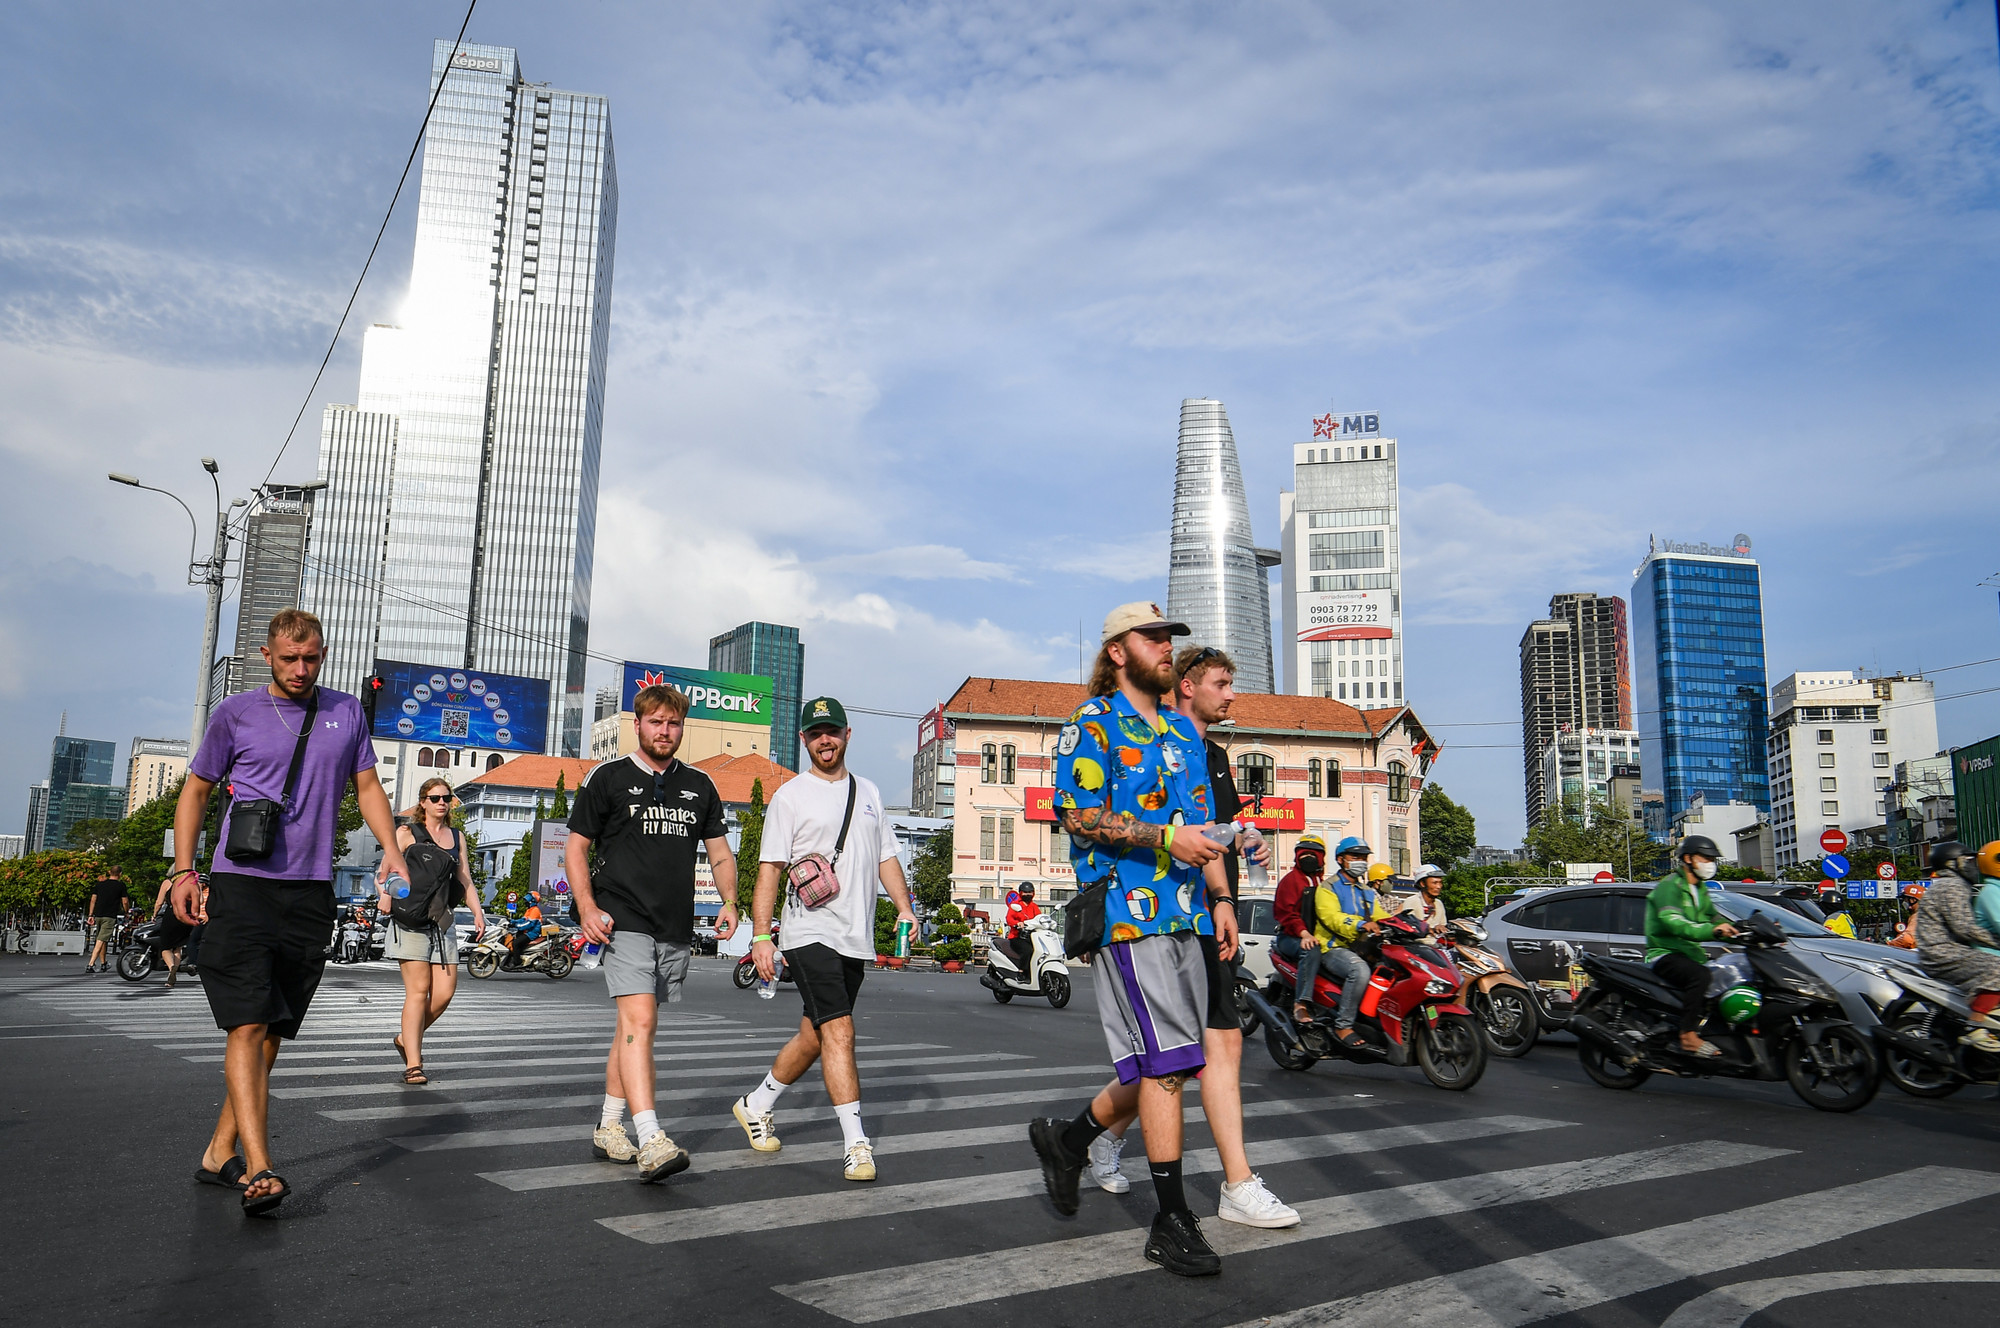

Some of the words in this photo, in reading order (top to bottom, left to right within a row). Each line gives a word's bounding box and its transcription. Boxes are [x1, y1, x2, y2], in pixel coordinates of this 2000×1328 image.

[450, 54, 499, 70] Keppel
[1343, 414, 1379, 434] MB
[266, 500, 300, 510] Keppel
[1310, 606, 1334, 614] 0903
[1337, 605, 1348, 613] 79
[1351, 604, 1363, 612] 77
[1365, 604, 1377, 612] 99
[1310, 616, 1334, 624] 0906
[1337, 615, 1348, 623] 68
[1351, 615, 1363, 623] 22
[1366, 614, 1377, 622] 22
[446, 692, 468, 703] VTV
[675, 684, 760, 714] VPBank
[1969, 755, 1994, 772] VPBank
[1037, 797, 1053, 810] CHỦ
[1244, 805, 1258, 818] CỦ
[1260, 807, 1283, 819] CHÚNG
[1285, 809, 1295, 819] TA
[643, 821, 659, 835] FLY
